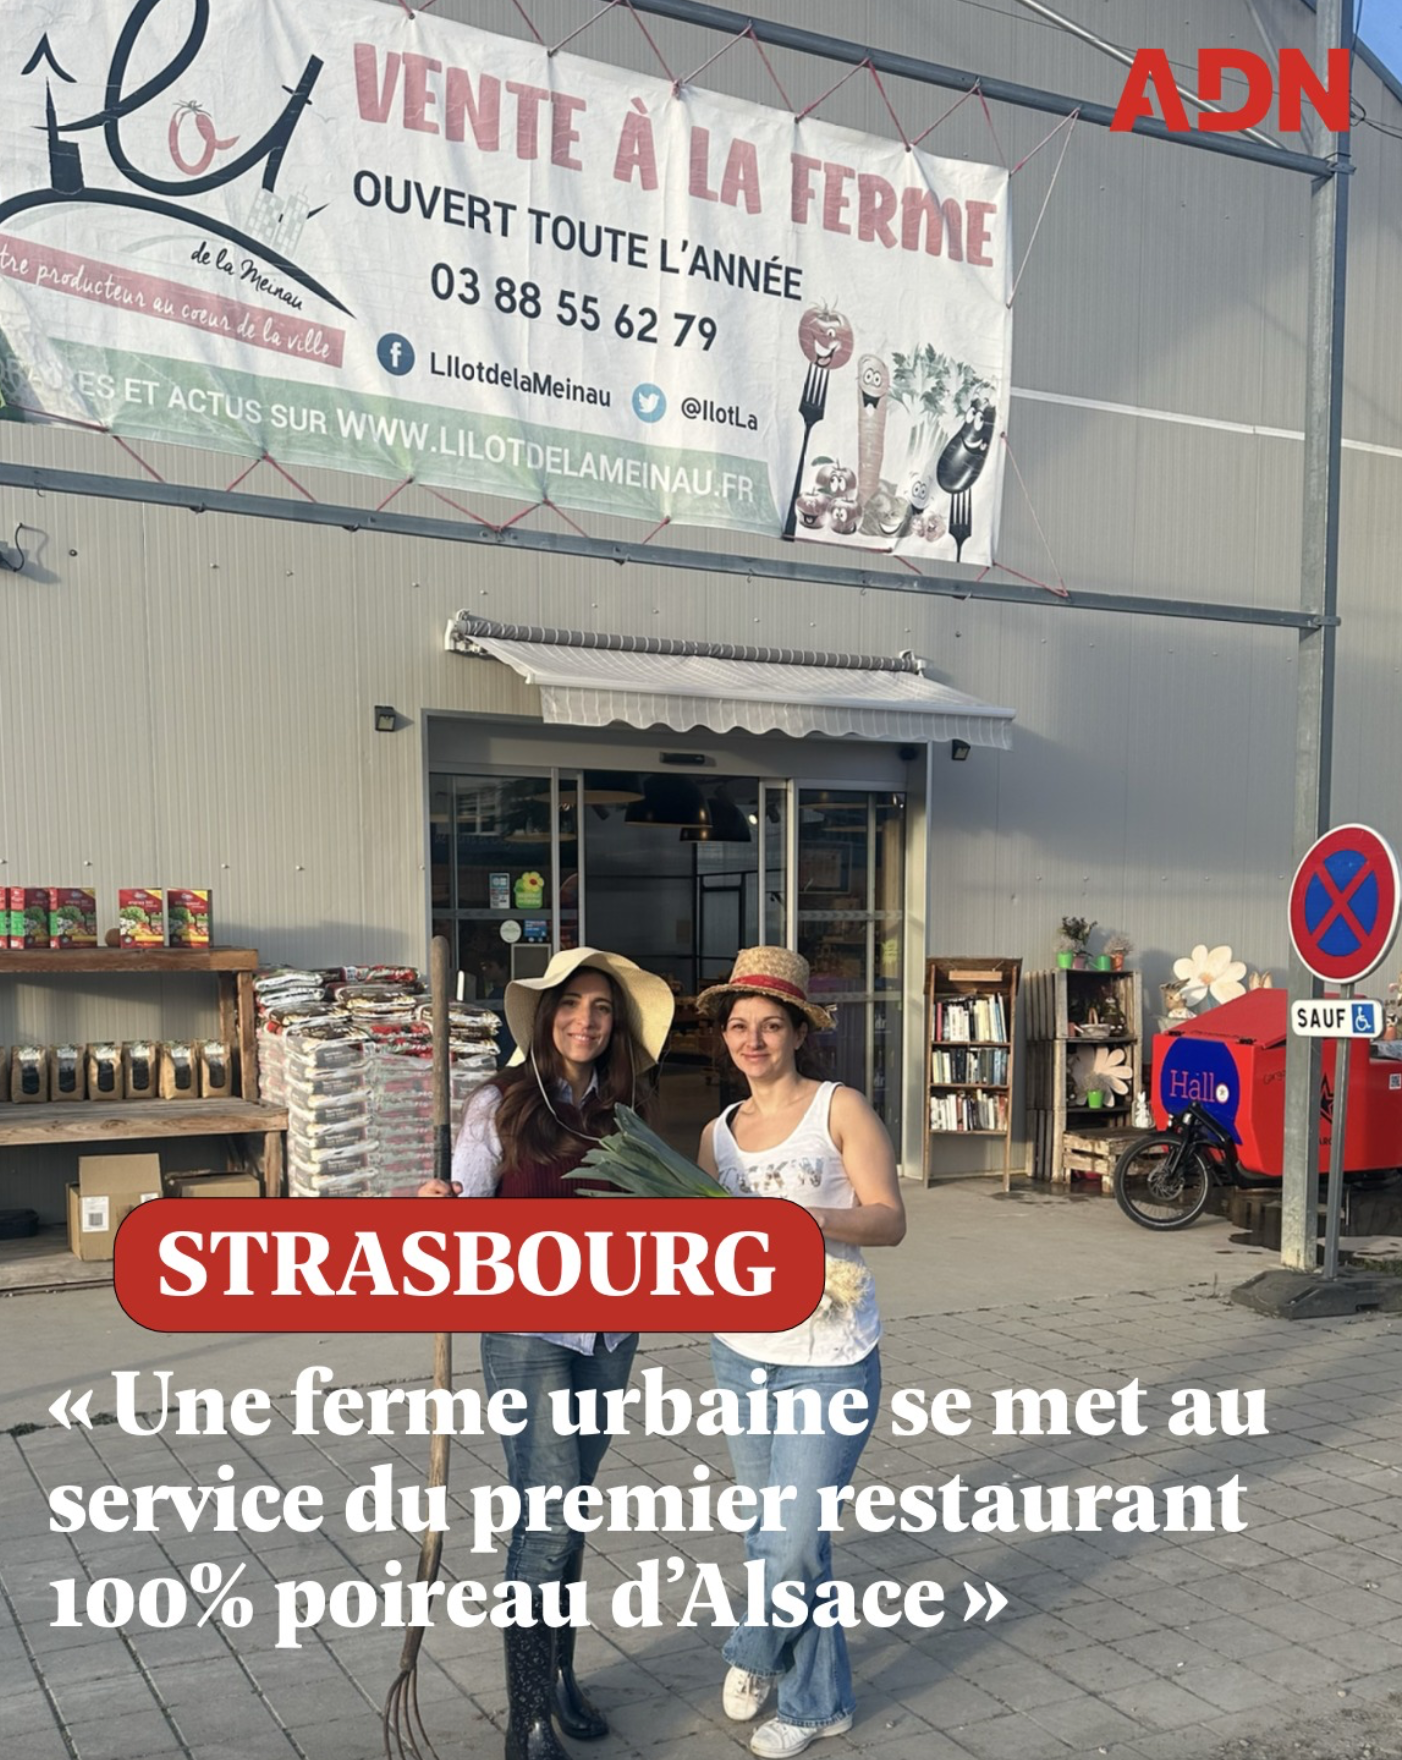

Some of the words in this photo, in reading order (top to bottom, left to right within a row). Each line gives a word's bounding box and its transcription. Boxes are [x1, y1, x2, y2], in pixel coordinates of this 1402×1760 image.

[354, 43, 587, 172] VENTE
[613, 97, 659, 191] À
[689, 126, 762, 215] LA
[791, 153, 996, 267] FERME
[191, 241, 211, 265] de
[216, 248, 234, 276] la
[240, 259, 303, 311] Meinau
[353, 170, 517, 238] OUVERT
[528, 207, 649, 269] TOUTE
[660, 239, 803, 301] L’ANNÉE
[36, 264, 147, 308] producteur
[153, 296, 175, 317] au
[237, 312, 256, 340] de
[263, 317, 282, 347] la
[287, 327, 331, 359] ville
[431, 262, 480, 305] 03
[494, 276, 541, 319] 88
[556, 289, 600, 332] 55
[614, 303, 658, 344] 62
[673, 313, 718, 352] 79
[124, 377, 160, 406] ET
[167, 388, 262, 425] ACTUS
[270, 404, 327, 435] SUR
[336, 407, 754, 503] WWW.LILOTDELAMEINAU.FR
[1296, 1008, 1347, 1029] SAUF
